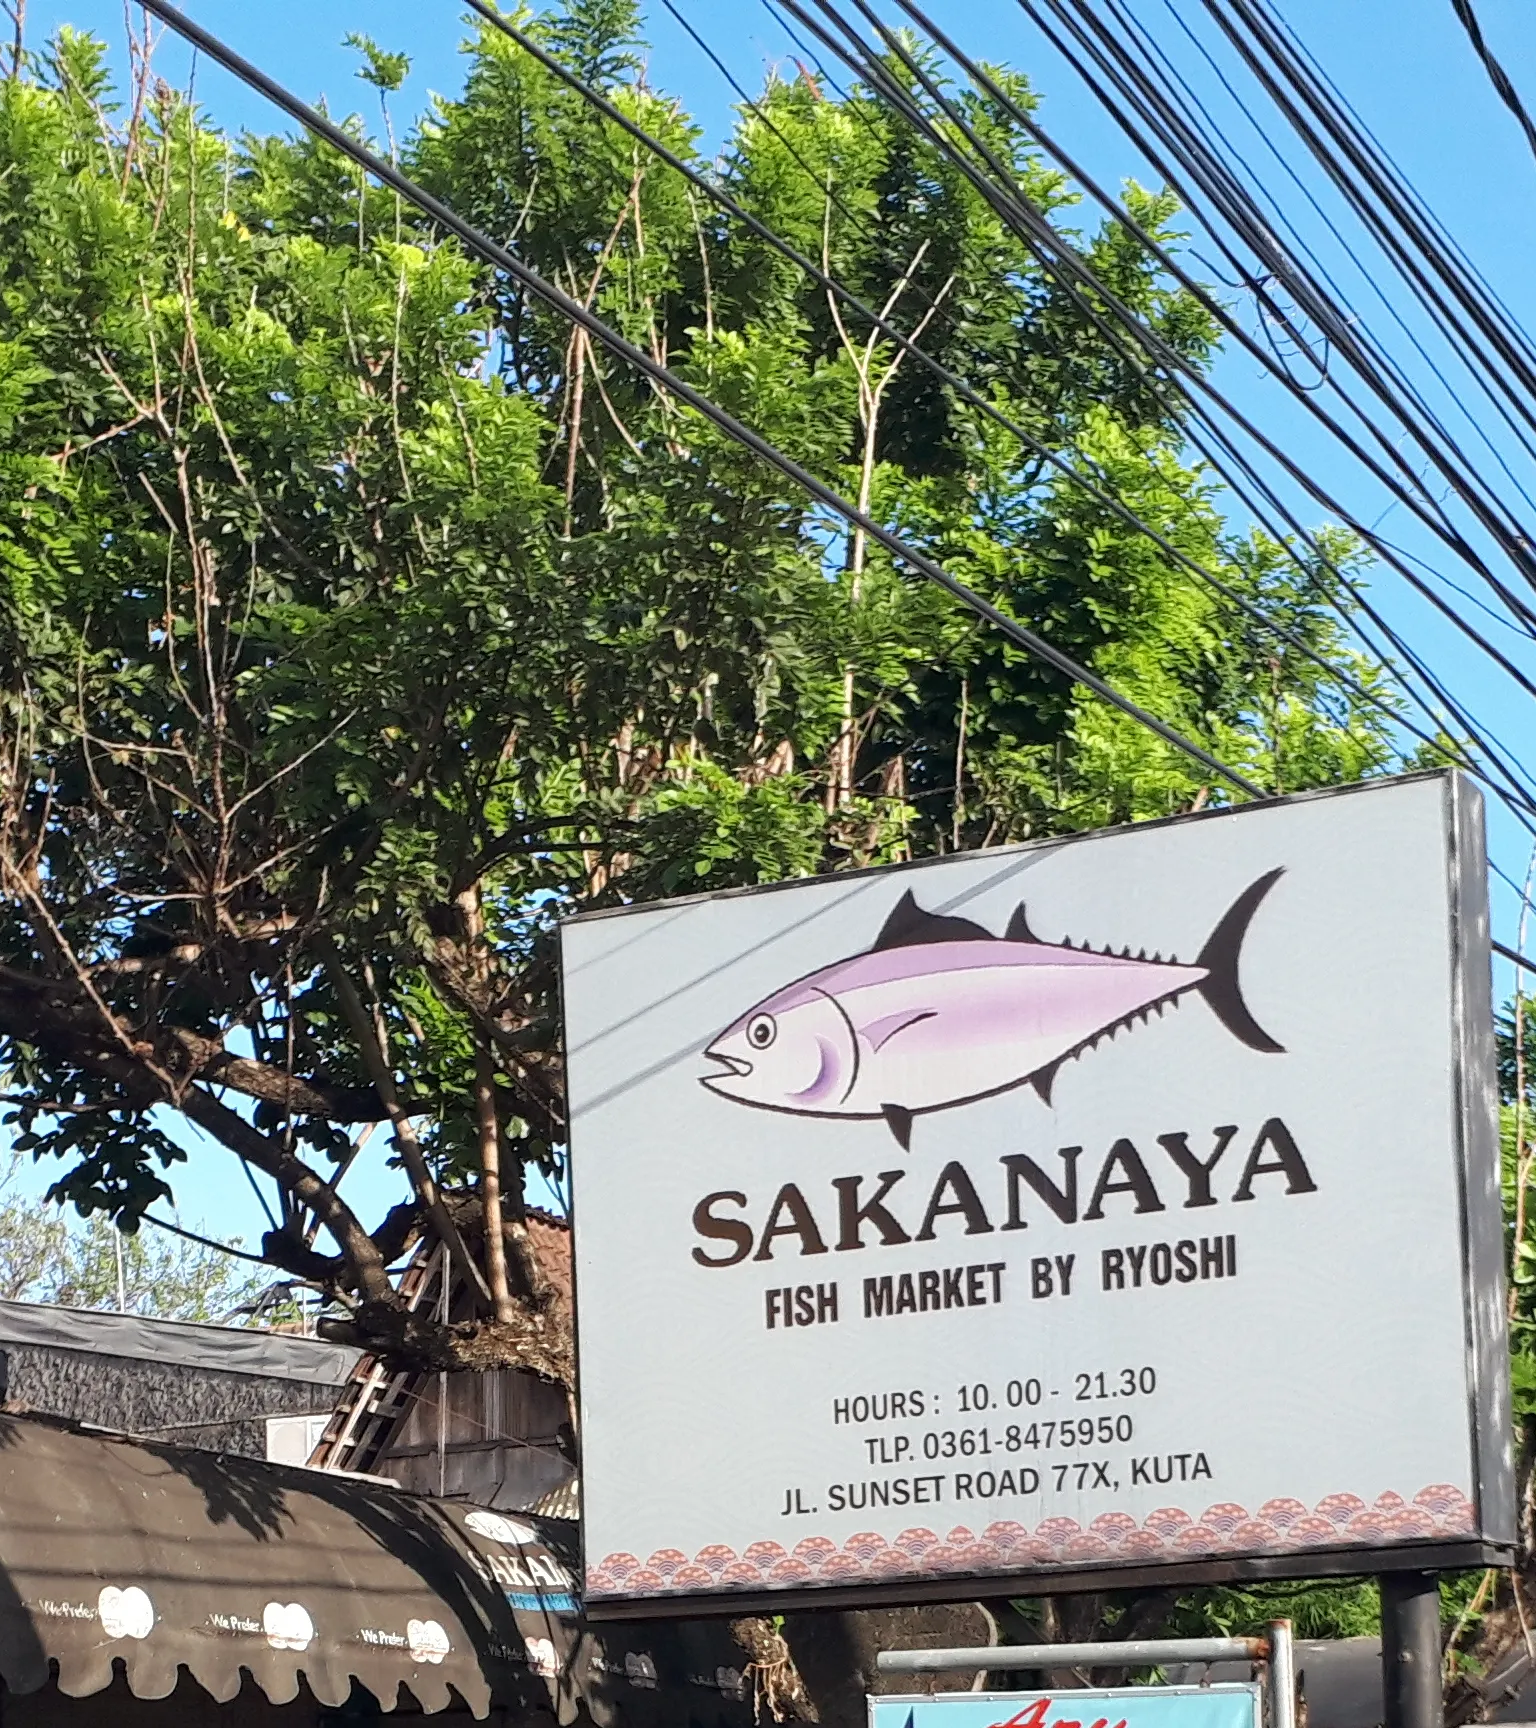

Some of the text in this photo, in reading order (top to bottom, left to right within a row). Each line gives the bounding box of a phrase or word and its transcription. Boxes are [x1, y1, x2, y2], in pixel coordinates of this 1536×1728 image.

[692, 1118, 1317, 1267] SAKANAYA
[765, 1235, 1237, 1330] FISH MARKET BY RYOSHI
[1075, 1366, 1156, 1401] 21.30
[864, 1414, 1133, 1465] TLP. 0361-8475950
[781, 1452, 1213, 1516] JL. SUNSET ROAD 77X, KUTA
